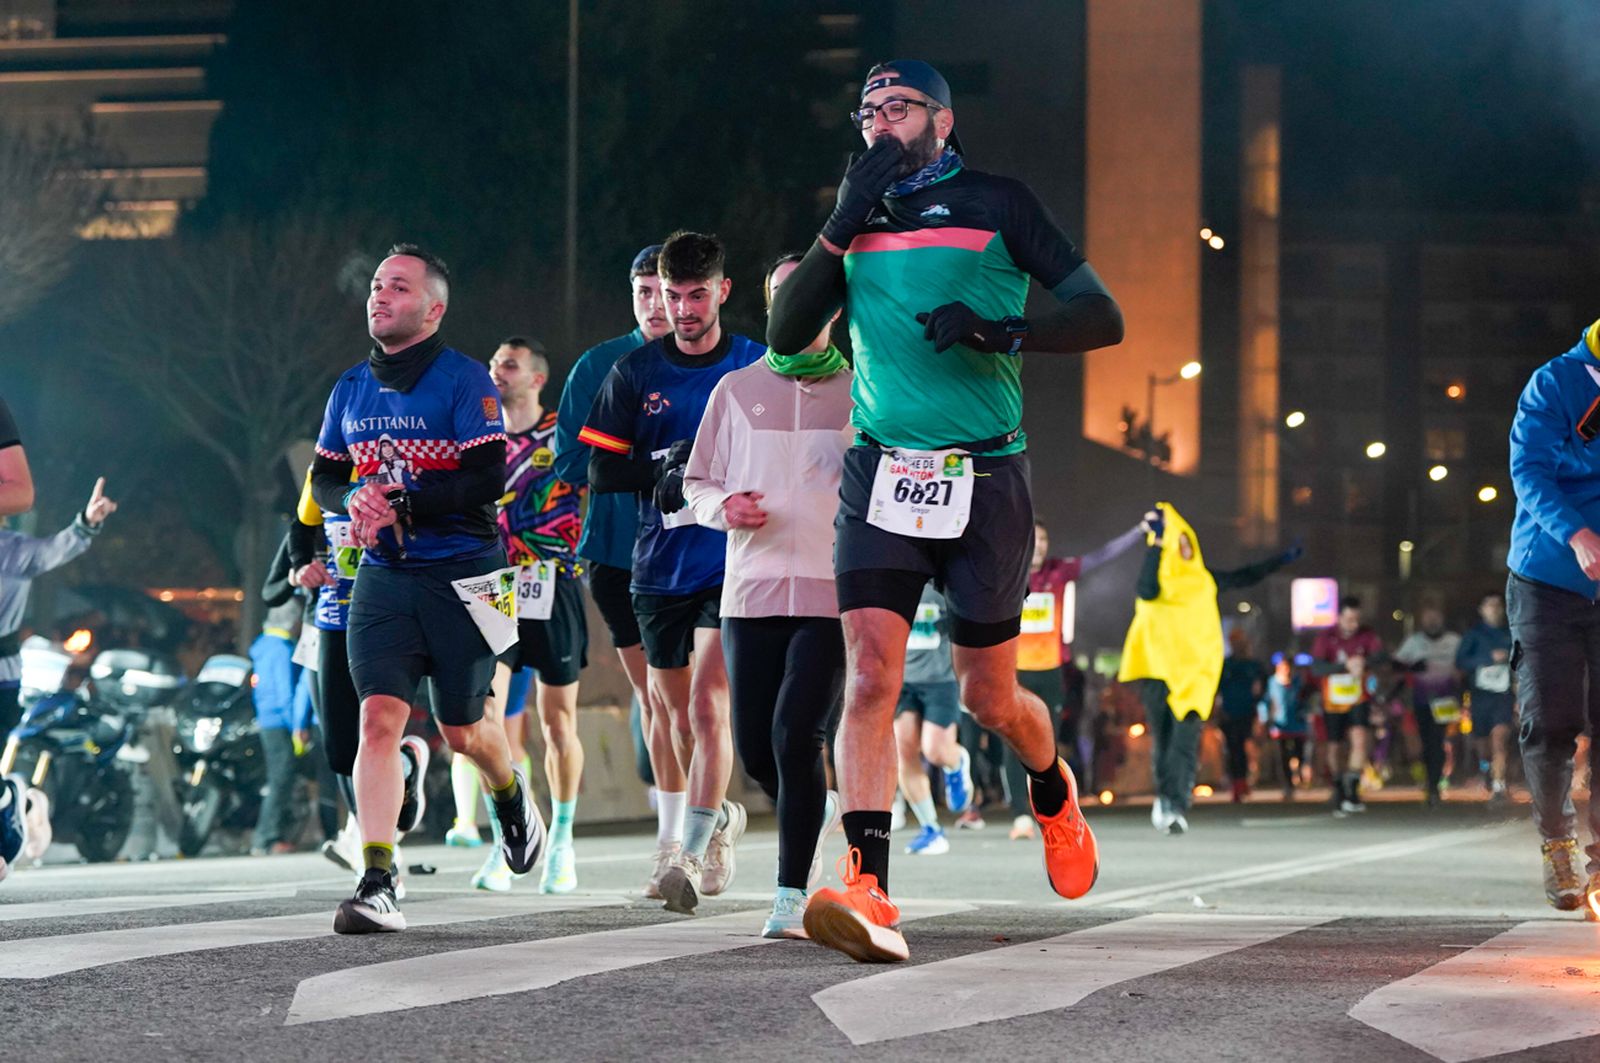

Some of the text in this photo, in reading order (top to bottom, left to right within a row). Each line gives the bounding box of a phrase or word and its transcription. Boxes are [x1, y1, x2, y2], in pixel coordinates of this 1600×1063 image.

[346, 415, 428, 435] BASTITANIA
[890, 464, 909, 475] SAN
[894, 477, 953, 507] 6827
